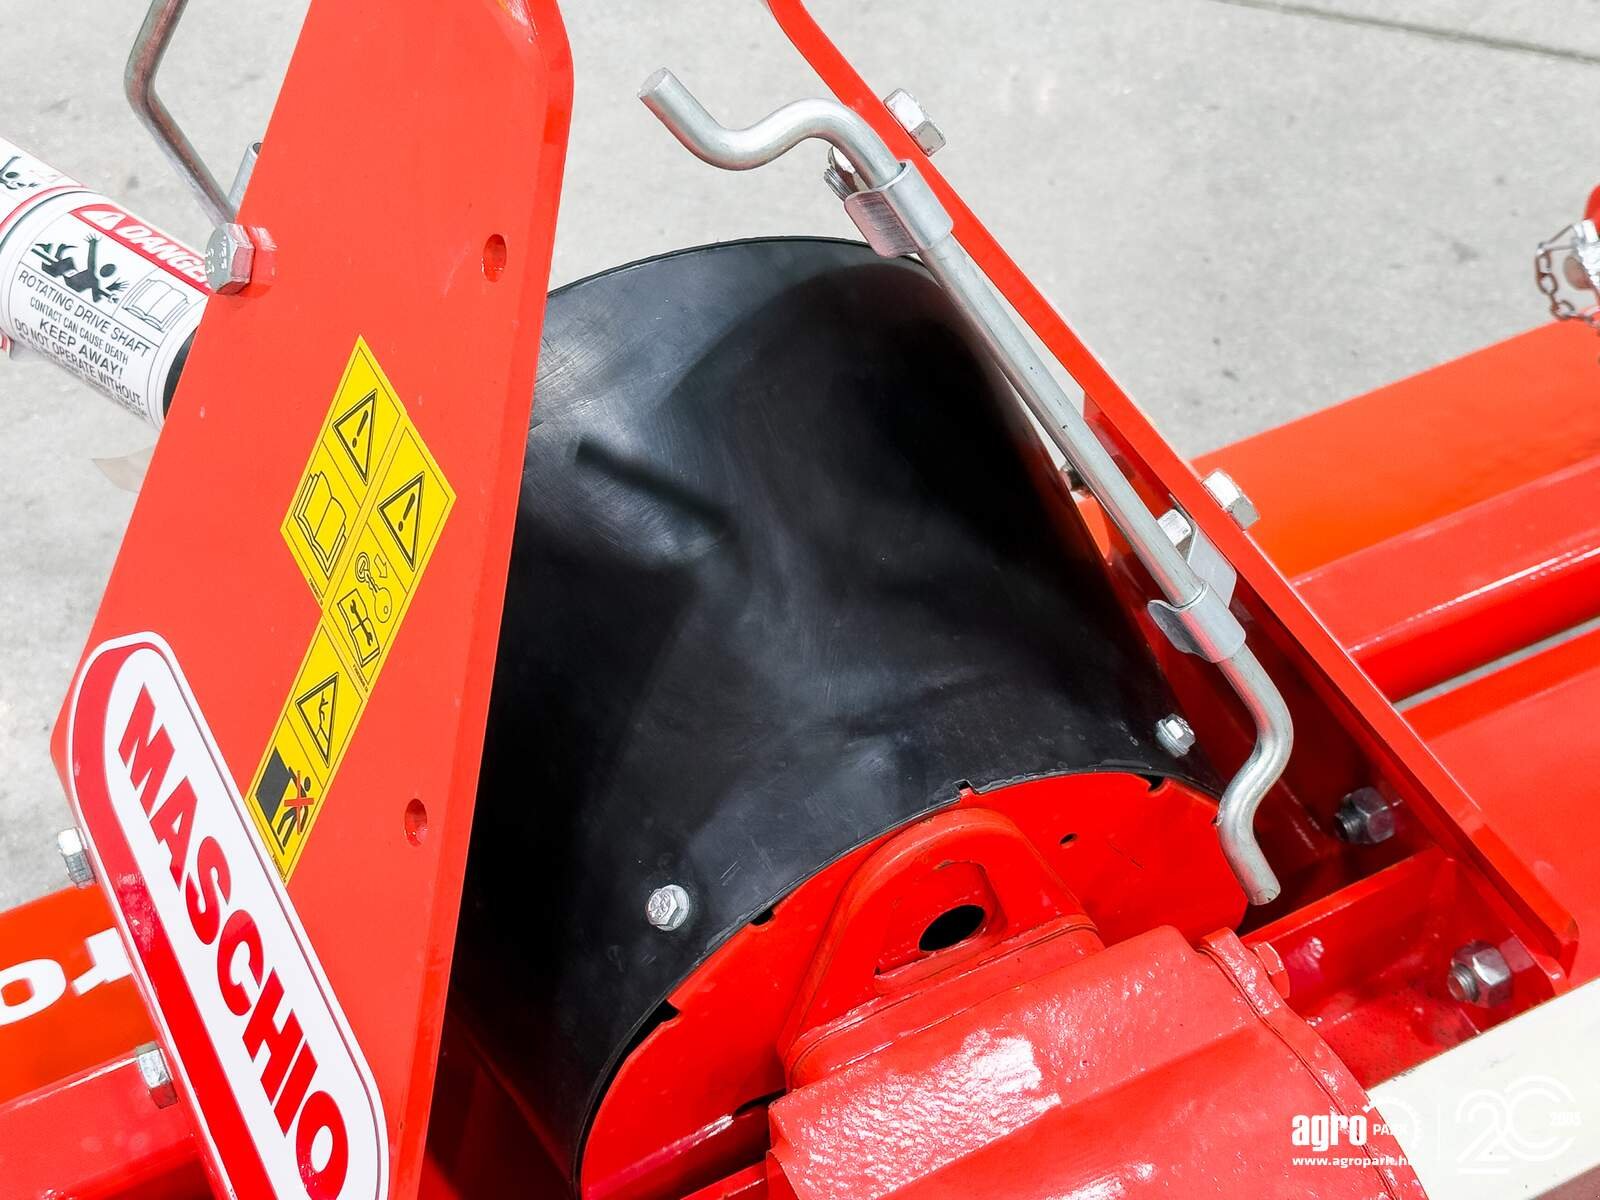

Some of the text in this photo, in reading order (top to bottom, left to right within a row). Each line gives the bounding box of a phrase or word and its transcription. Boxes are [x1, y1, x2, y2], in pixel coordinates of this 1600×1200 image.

[114, 225, 207, 283] DANGE
[18, 269, 150, 357] ROTATING DRIVE SHAFT
[30, 296, 62, 322] CONTACT
[63, 316, 79, 334] CAN
[79, 327, 104, 350] CAUSE
[104, 342, 128, 366] DEATH
[14, 317, 29, 336] DO
[30, 327, 50, 350] NOT
[51, 340, 97, 378] OPERATE
[40, 318, 76, 346] KEEP
[79, 344, 123, 379] AWAY!
[118, 683, 349, 1200] MASCHIO
